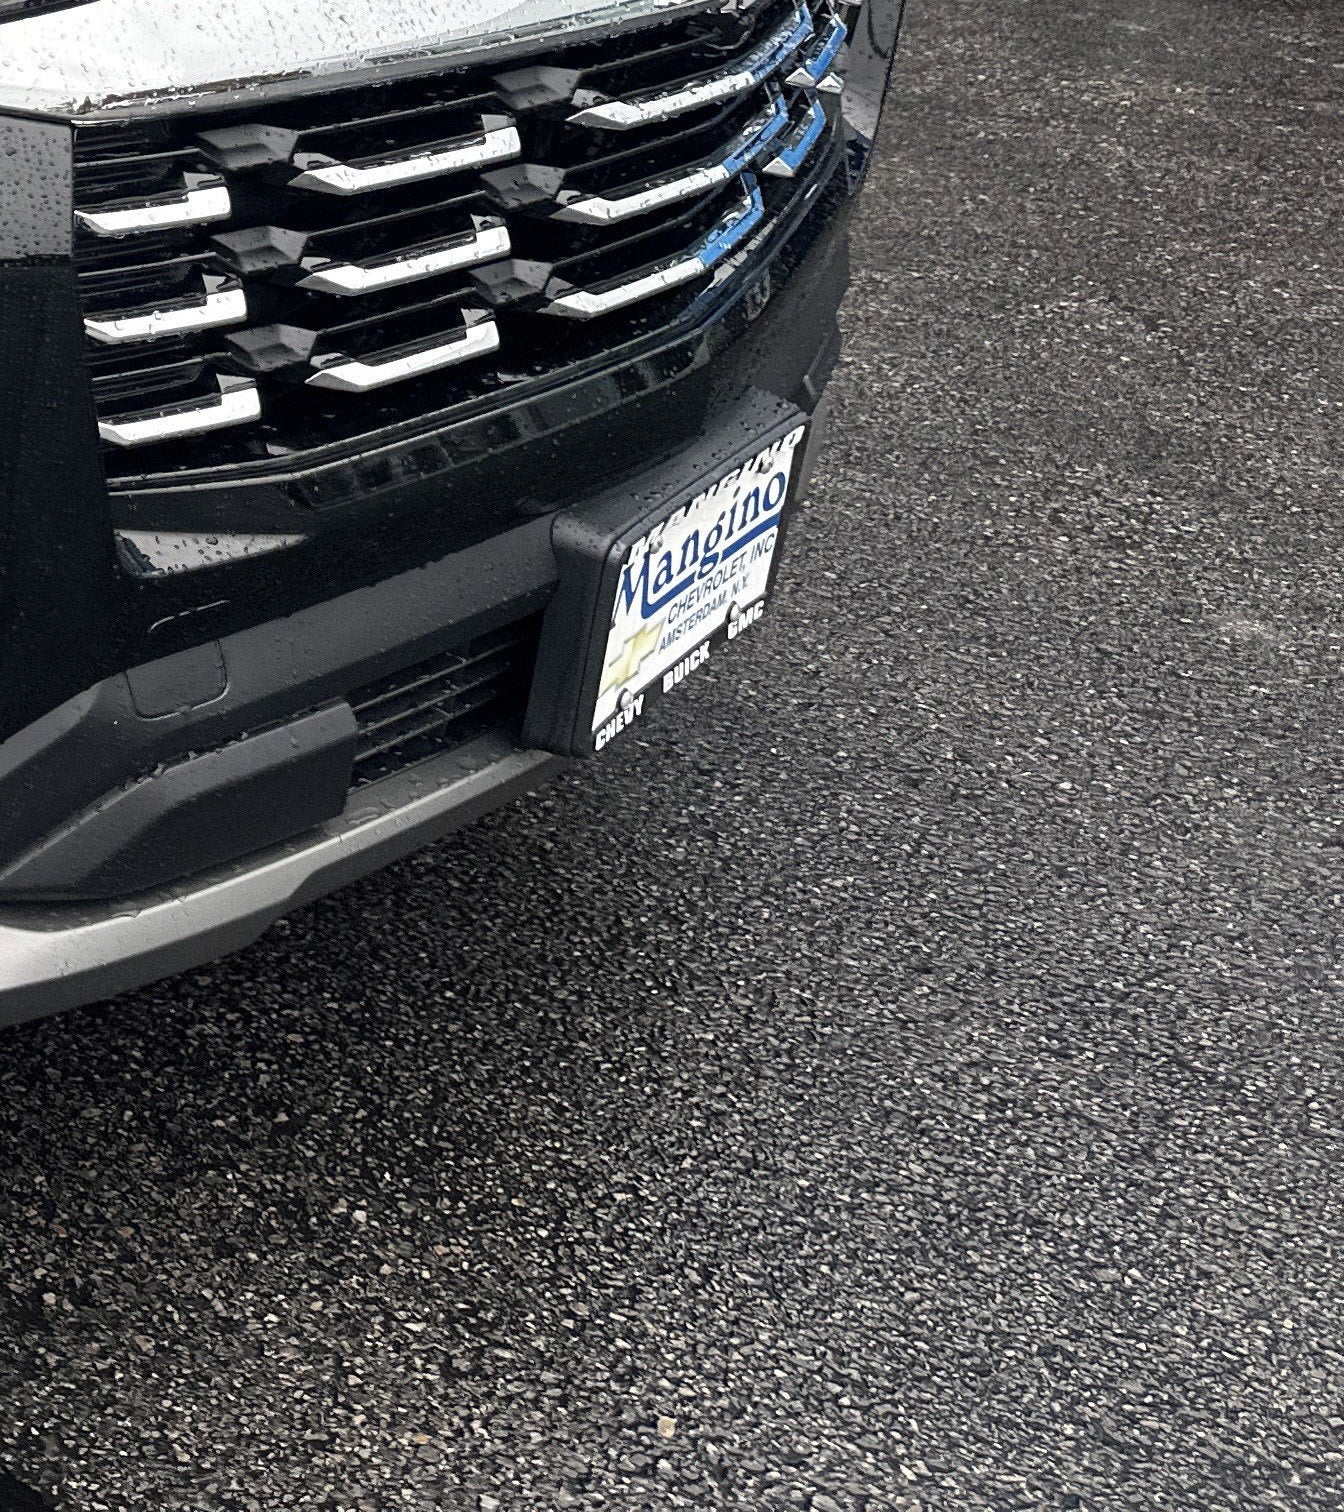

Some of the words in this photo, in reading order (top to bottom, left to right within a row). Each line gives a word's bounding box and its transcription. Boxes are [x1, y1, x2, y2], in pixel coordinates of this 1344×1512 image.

[612, 471, 786, 627] Mangino
[595, 694, 645, 751] CHEVY
[662, 640, 711, 694] BUICK
[727, 600, 765, 640] GMC
